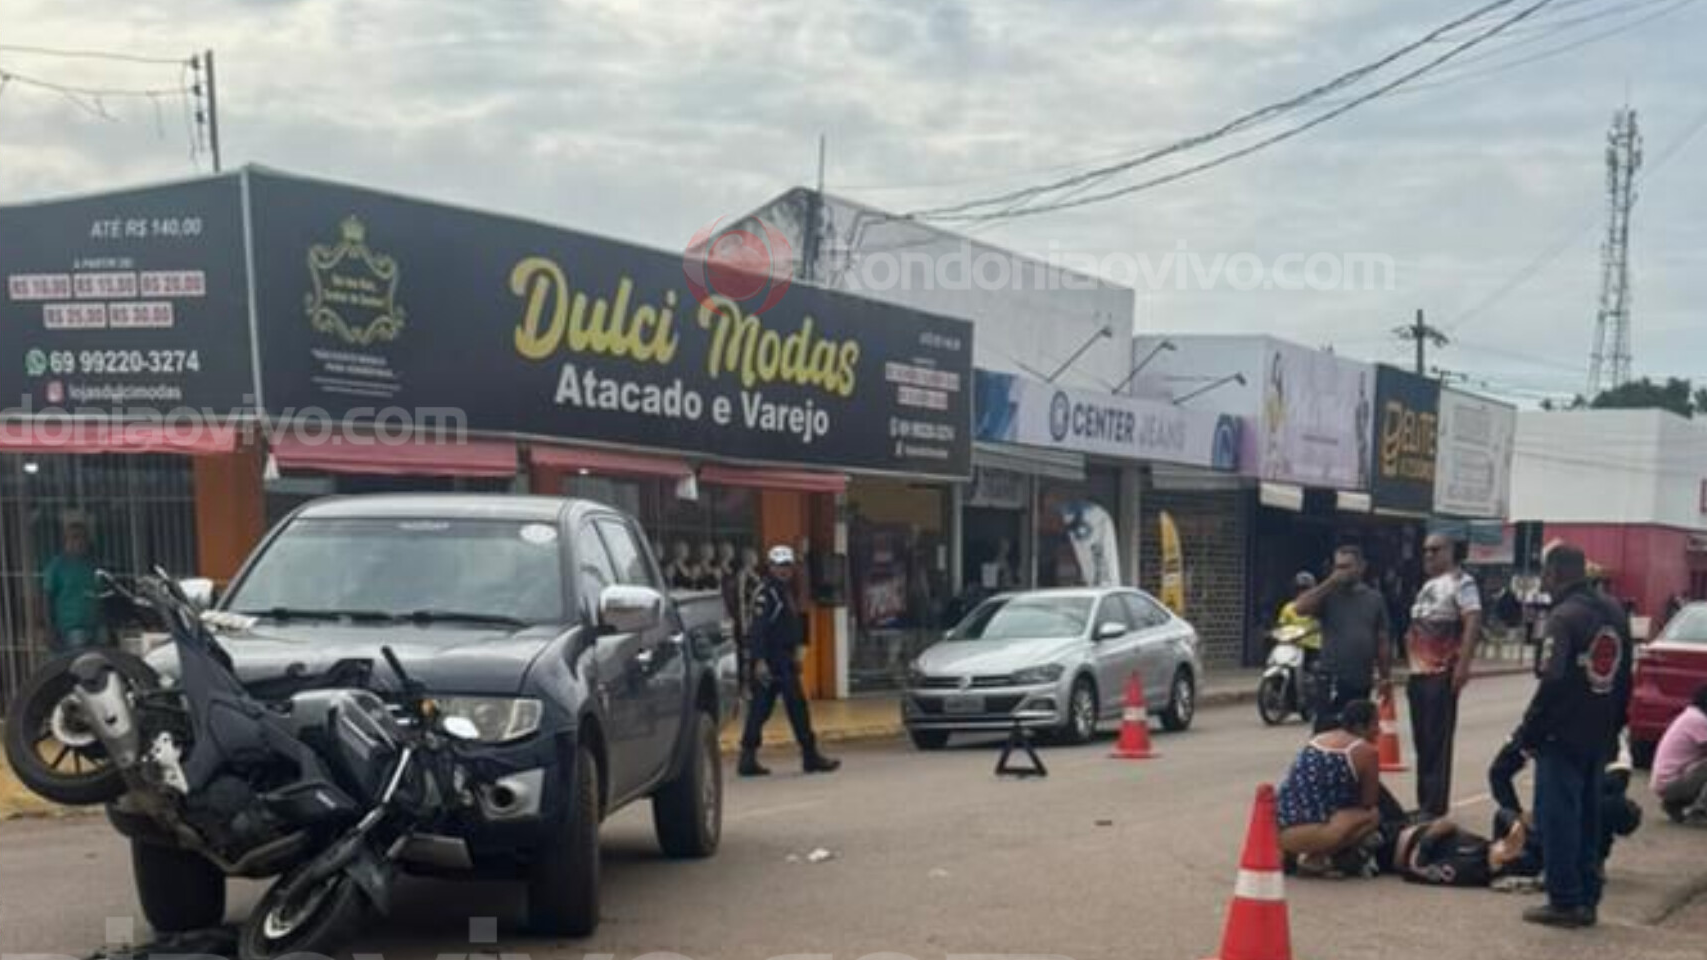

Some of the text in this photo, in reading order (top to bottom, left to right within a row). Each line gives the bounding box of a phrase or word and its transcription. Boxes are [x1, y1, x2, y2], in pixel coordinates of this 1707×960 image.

[91, 217, 120, 238] ATÉ
[125, 217, 148, 238] R$
[509, 257, 860, 397] Dulci Modas
[50, 350, 200, 373] 69 99220-3274
[555, 363, 831, 444] Atacado e Varejo
[1072, 403, 1187, 450] CENTER JEANS
